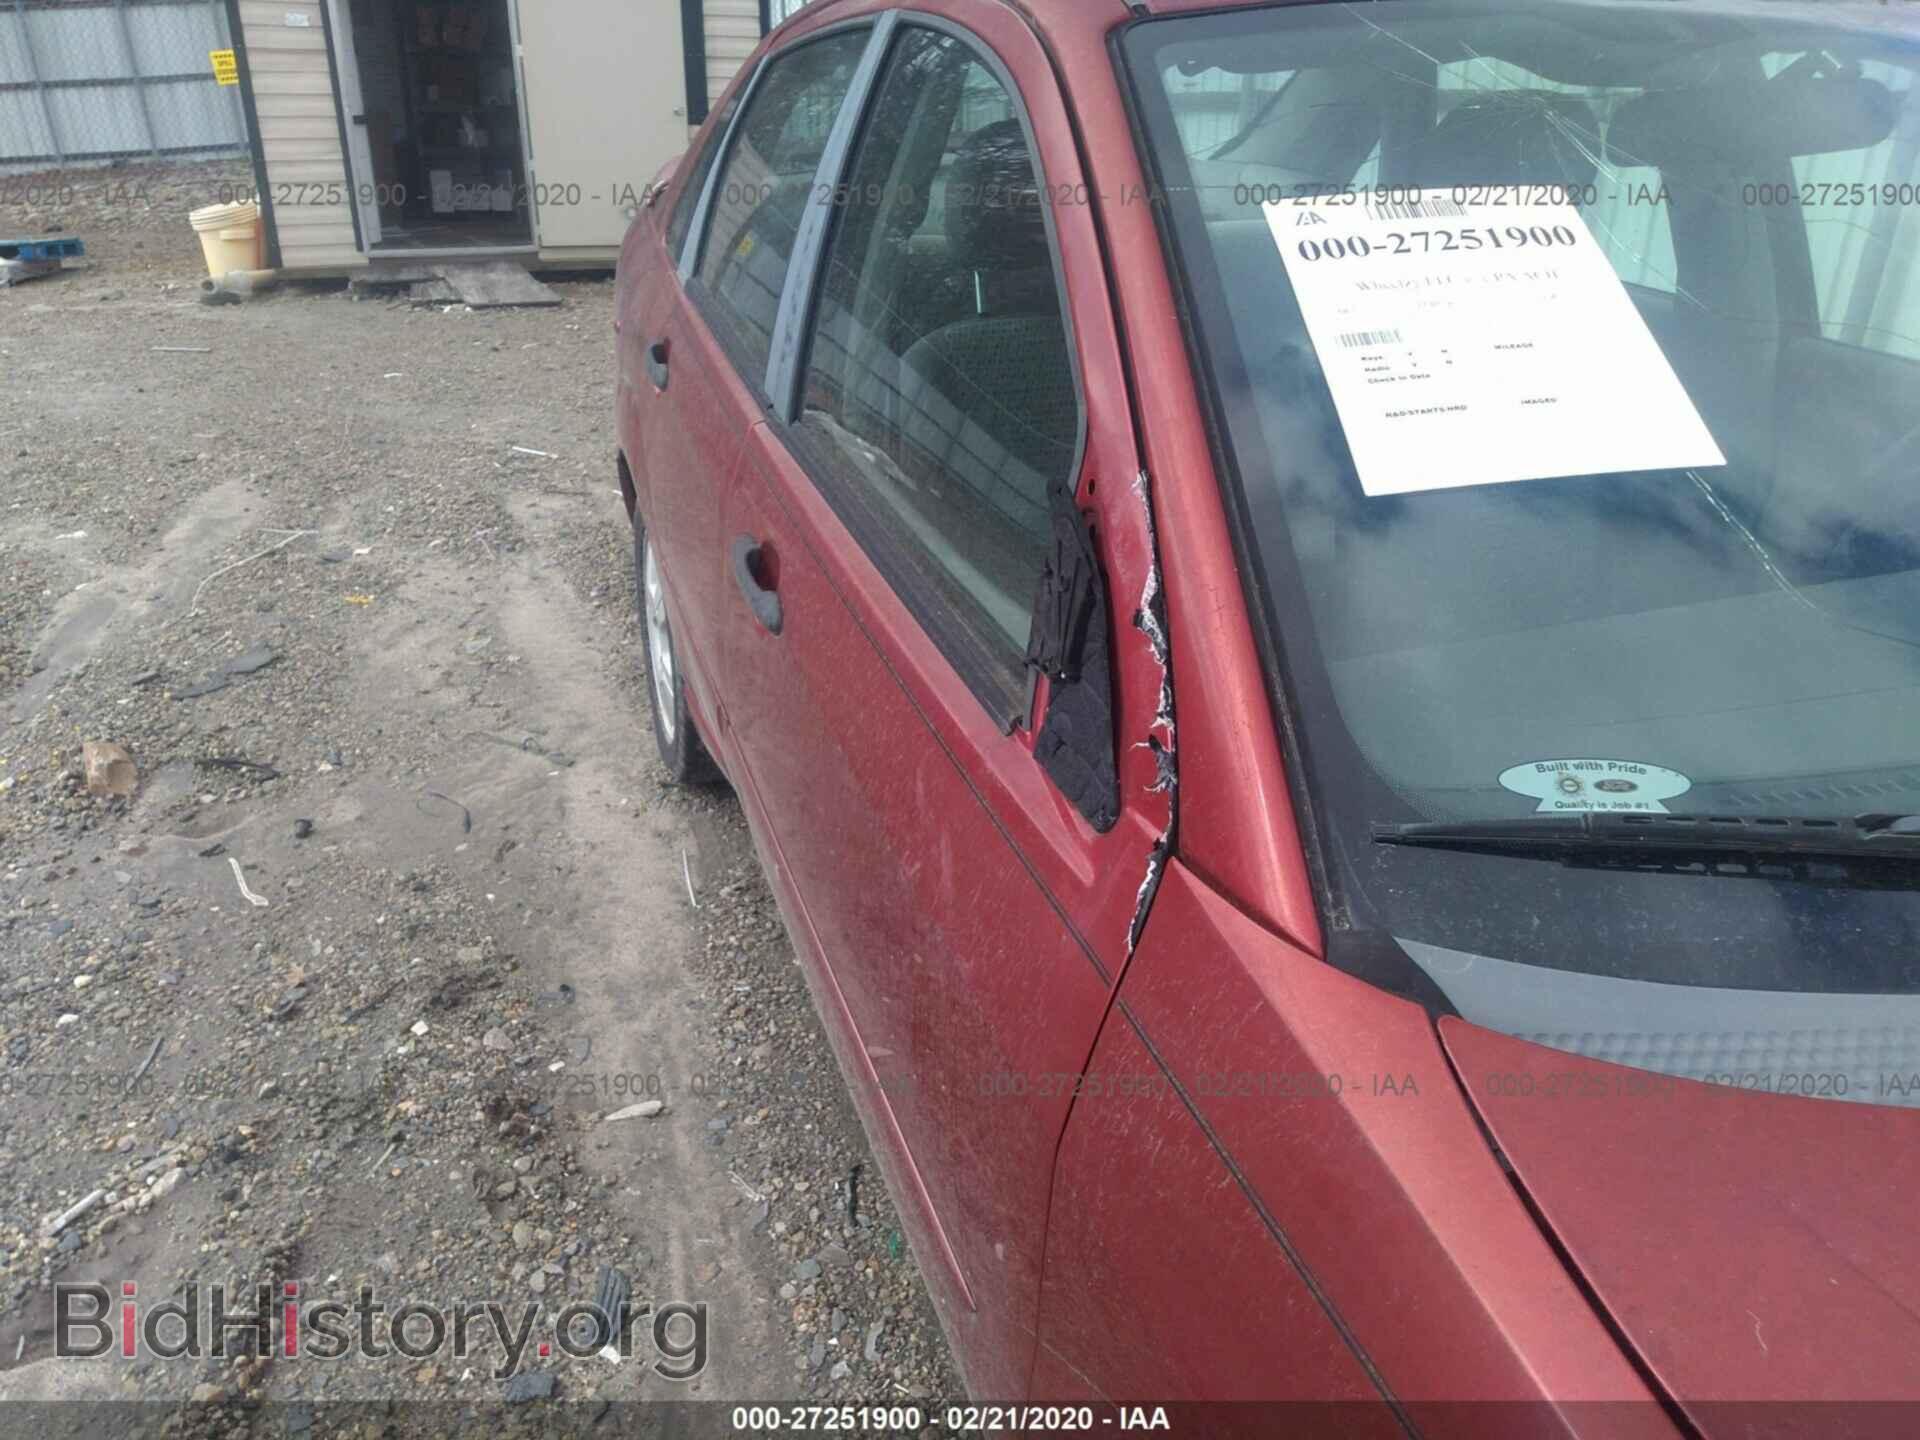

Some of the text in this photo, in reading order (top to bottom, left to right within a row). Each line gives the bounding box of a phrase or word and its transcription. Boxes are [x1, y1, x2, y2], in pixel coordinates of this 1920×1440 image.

[1298, 225, 1577, 262] 000-27251900
[1535, 761, 1648, 775] Built with Pride
[1554, 801, 1595, 813] Quality
[1612, 800, 1632, 809] Job
